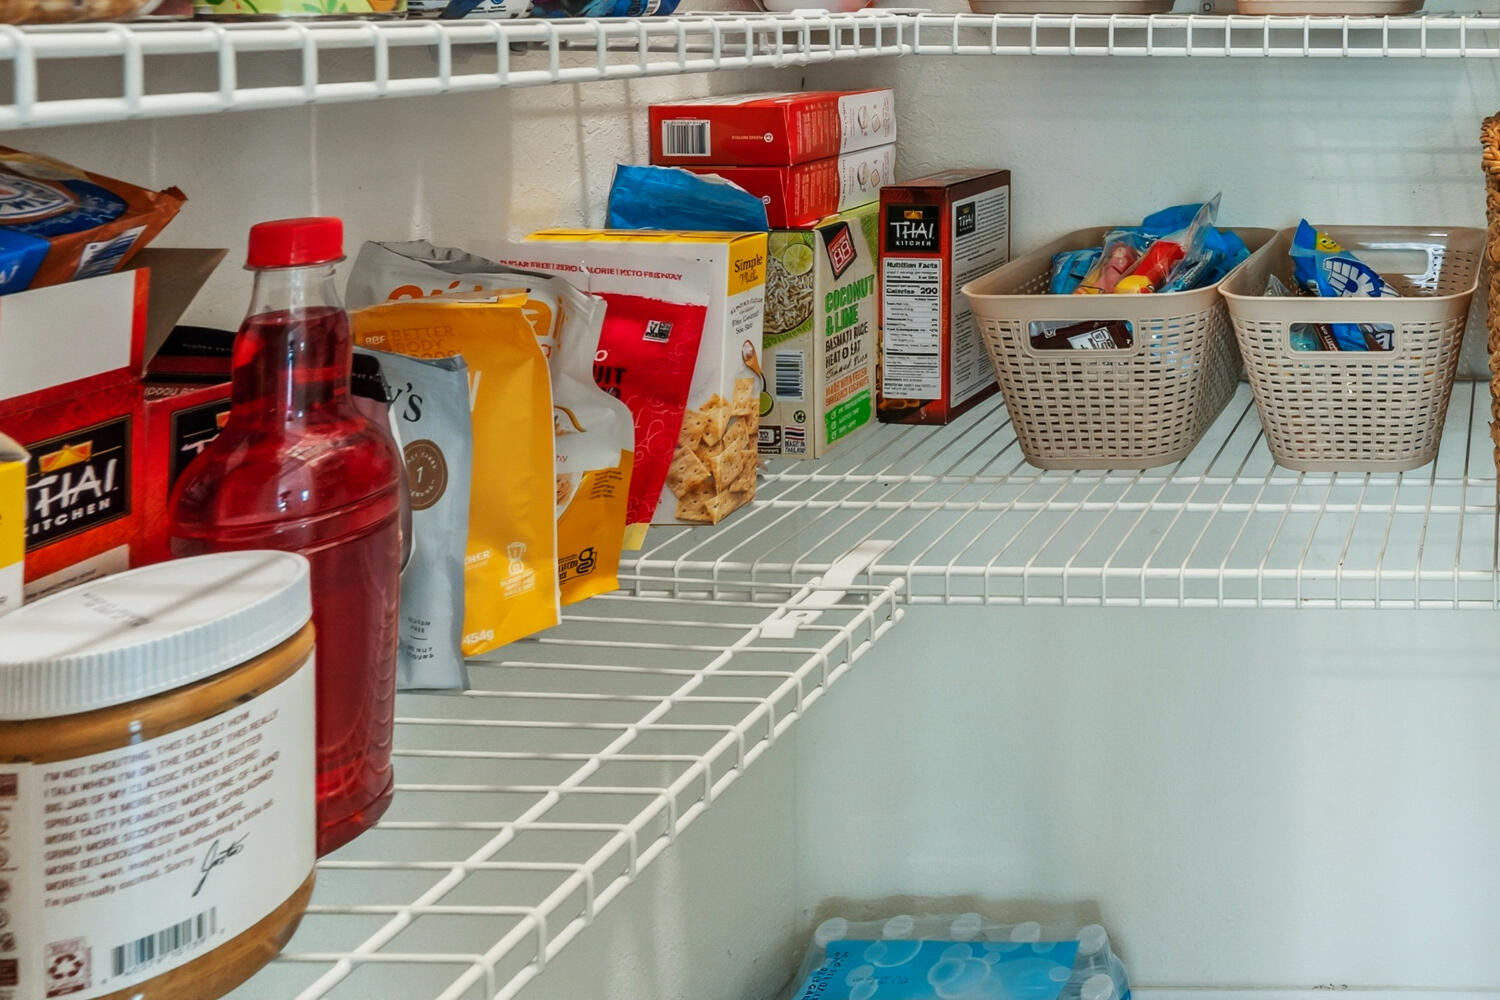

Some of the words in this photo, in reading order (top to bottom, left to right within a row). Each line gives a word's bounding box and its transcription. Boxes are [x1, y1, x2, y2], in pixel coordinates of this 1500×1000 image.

[890, 220, 935, 240] THAI
[556, 263, 578, 273] ZERO
[620, 268, 643, 278] KETO
[734, 253, 764, 273] Simple
[886, 261, 917, 269] Nutrition
[918, 261, 939, 269] Facts
[825, 273, 876, 315] COCONUT
[834, 302, 860, 334] LIME
[392, 325, 455, 341] BETTER
[393, 339, 442, 353] BODY
[825, 349, 841, 370] HEAT
[26, 457, 120, 519] THAI
